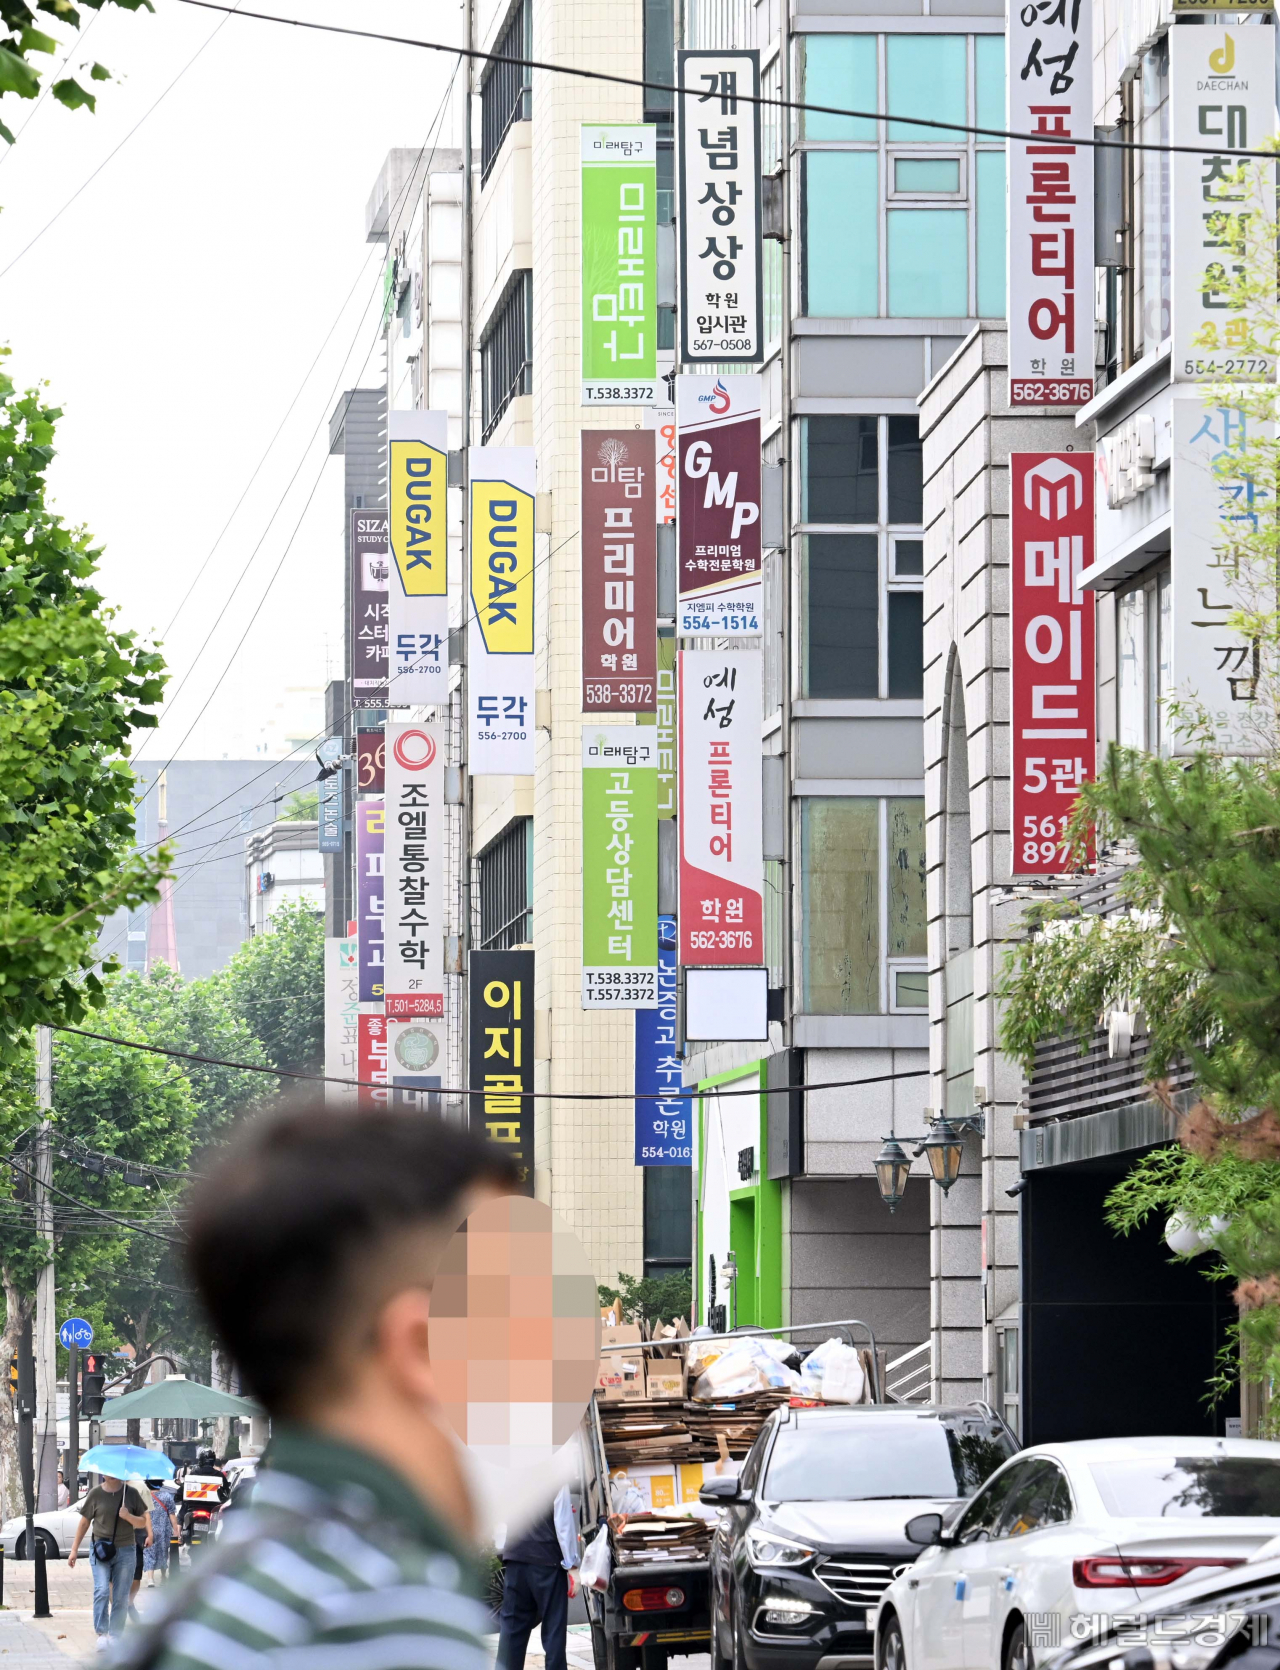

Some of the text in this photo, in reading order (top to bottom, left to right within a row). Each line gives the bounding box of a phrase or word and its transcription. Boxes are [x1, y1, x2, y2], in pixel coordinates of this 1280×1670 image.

[1197, 81, 1248, 90] DAECHAN
[593, 138, 644, 156] 미래탐구
[698, 72, 743, 281] 개념상상
[1026, 106, 1076, 354] 프론티어
[592, 182, 645, 361] 미래탐구
[705, 292, 738, 309] 학원
[697, 315, 747, 334] 입시관
[693, 338, 752, 351] 567-0508
[1184, 360, 1269, 375] 554-2772
[586, 388, 653, 400] T.538.3372
[1013, 383, 1091, 401] 562-3676
[592, 466, 645, 499] 미탐
[684, 441, 759, 539] GMP
[406, 458, 432, 571] DUGAK
[357, 520, 388, 533] SIZA
[357, 535, 381, 543] STUDY
[694, 545, 742, 558] 프리미엄
[488, 500, 518, 626] DUGAK
[684, 559, 756, 572] 수학전문학원
[602, 507, 635, 650] 프리미어
[687, 603, 754, 613] 지엠피 수학학원
[357, 624, 389, 641] 스터
[683, 616, 759, 630] 554-1514
[1021, 535, 1087, 740] 메이드
[396, 633, 442, 662] 두각
[397, 665, 442, 674] 556-2700
[600, 653, 638, 672] 학원
[586, 684, 652, 704] 538-3372
[476, 695, 528, 727] 두각
[478, 731, 527, 741] 556-2700
[589, 742, 650, 764] 미래탐구
[1022, 757, 1087, 794] 5관
[708, 741, 733, 863] 프론티어
[606, 772, 634, 961] 고등상담센터
[397, 783, 430, 970] 조엘통찰수학
[700, 898, 744, 923] 학원
[690, 931, 752, 949] 562-3676
[408, 979, 423, 990] 2F
[586, 973, 655, 985] T.538.3372
[586, 989, 655, 1000] T.557.3372
[653, 1120, 686, 1140] 학원
